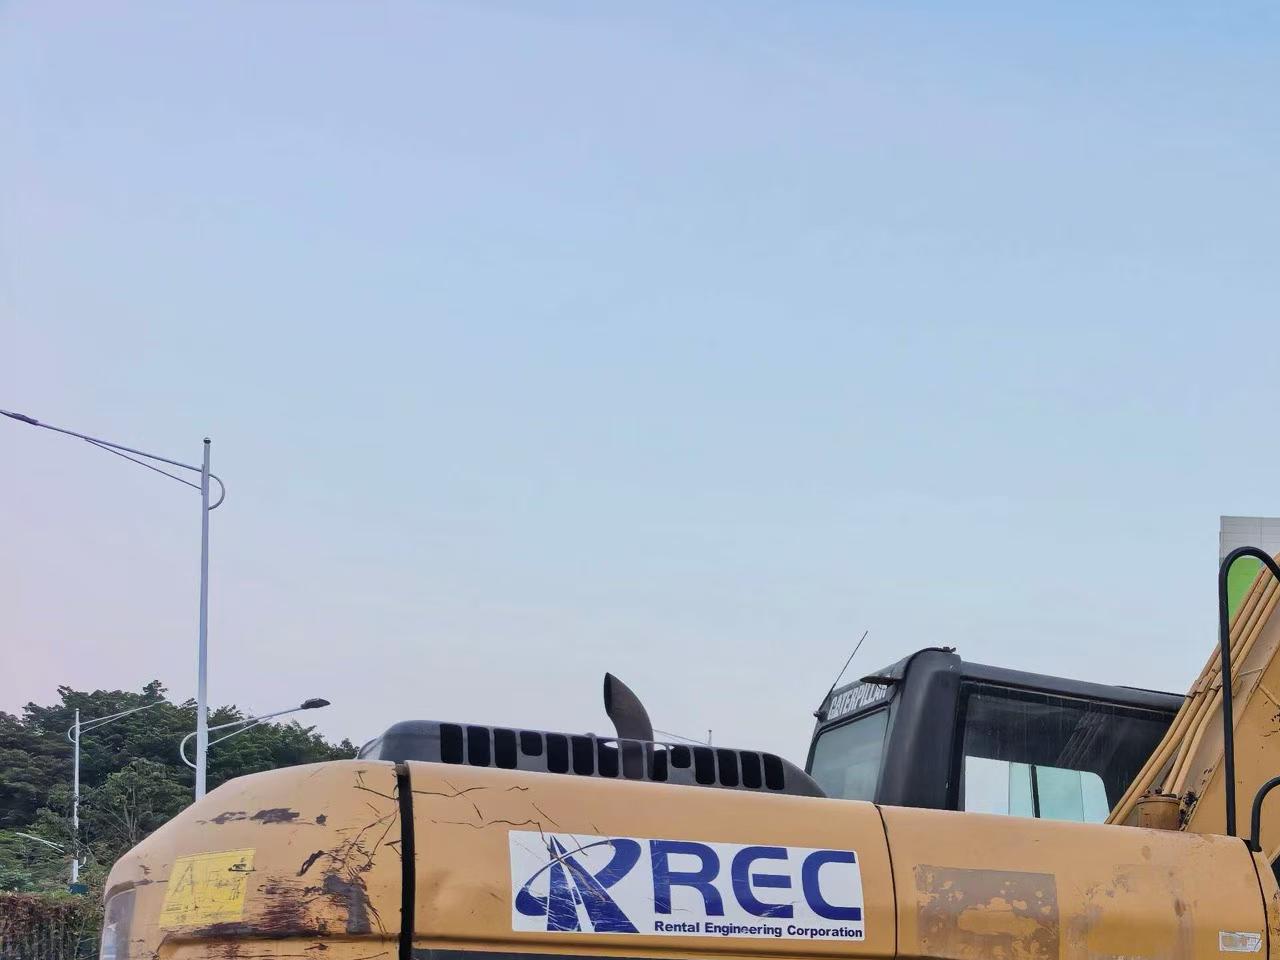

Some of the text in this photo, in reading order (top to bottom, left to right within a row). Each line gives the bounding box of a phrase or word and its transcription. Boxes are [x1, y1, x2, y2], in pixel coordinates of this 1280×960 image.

[827, 682, 888, 720] CATERPILLAR
[649, 840, 861, 920] REC
[654, 921, 863, 939] Rental Engineering Corporation
